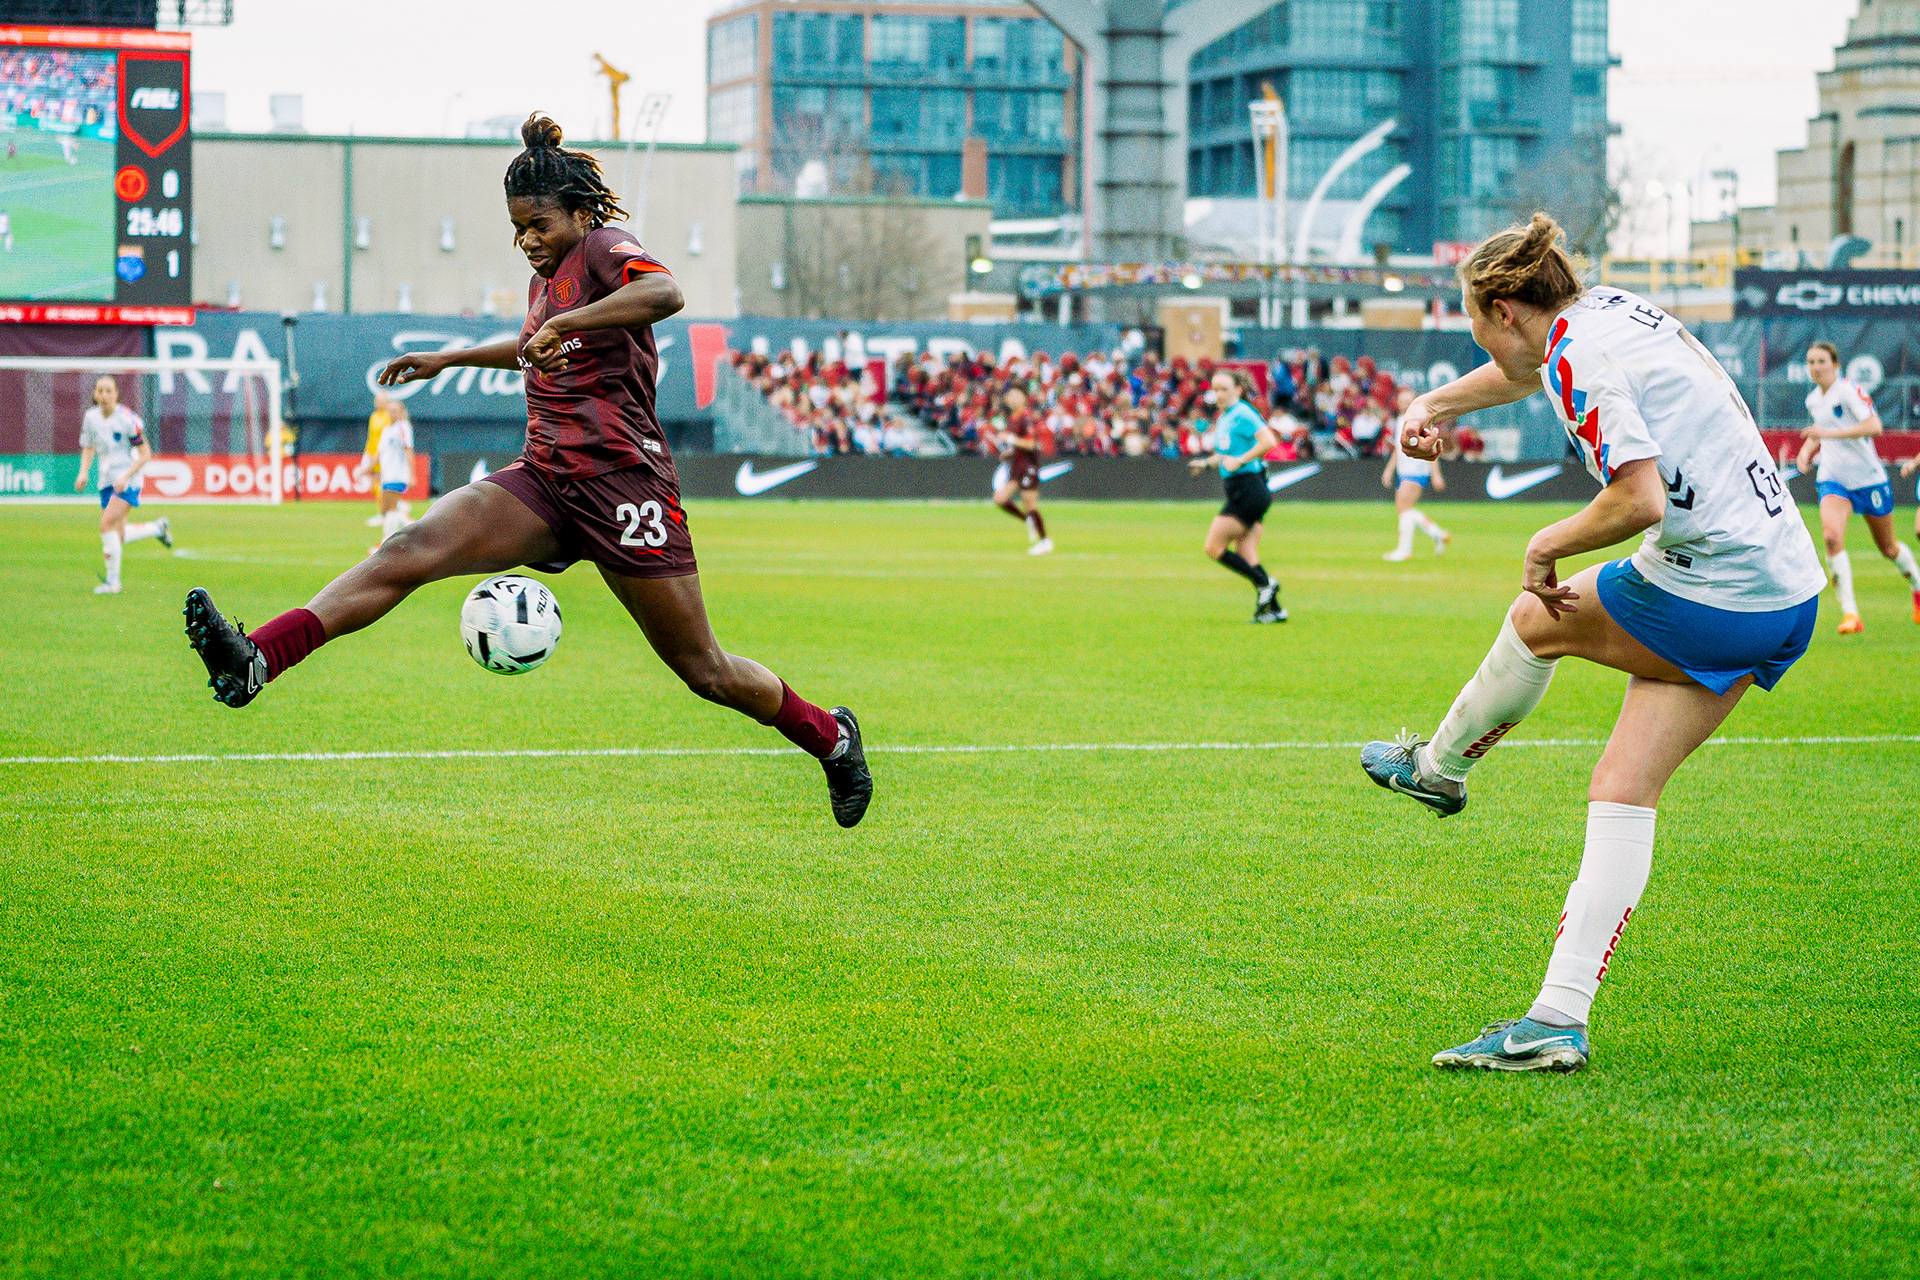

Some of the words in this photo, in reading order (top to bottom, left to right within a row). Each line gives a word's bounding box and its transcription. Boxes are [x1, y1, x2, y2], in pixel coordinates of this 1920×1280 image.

[162, 169, 179, 198] 0
[166, 250, 179, 278] 1
[0, 461, 45, 492] ins
[204, 464, 373, 493] DOORDAS
[616, 500, 668, 547] 23
